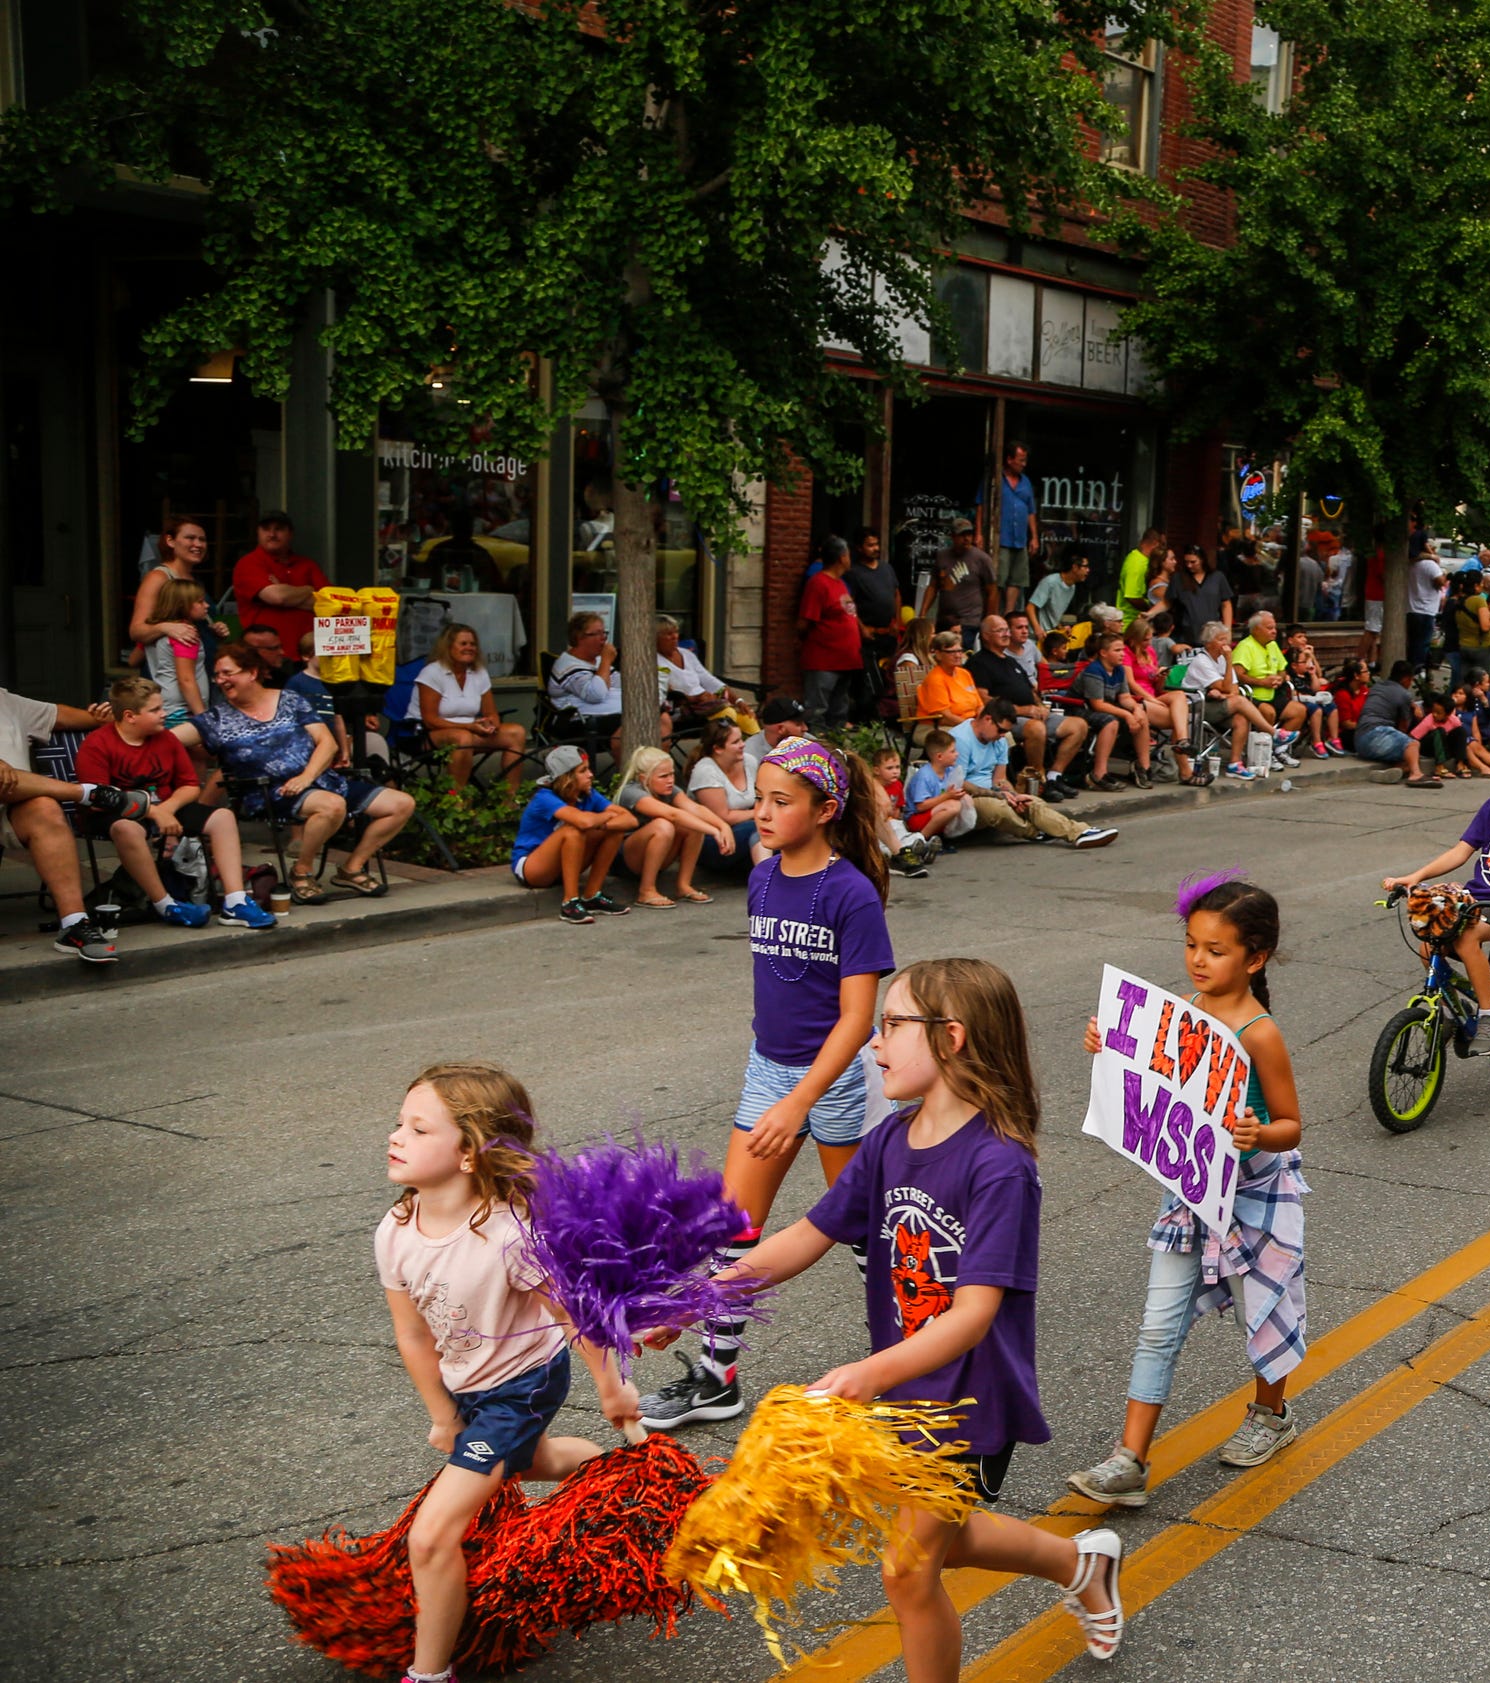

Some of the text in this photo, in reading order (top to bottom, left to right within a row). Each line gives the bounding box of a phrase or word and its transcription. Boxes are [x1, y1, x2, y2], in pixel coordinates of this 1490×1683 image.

[1087, 340, 1122, 367] BEER
[1040, 465, 1124, 512] mint
[905, 506, 936, 519] MINT
[318, 617, 367, 628] NO PARKING
[1105, 979, 1148, 1060] I
[894, 1186, 935, 1212] STREET
